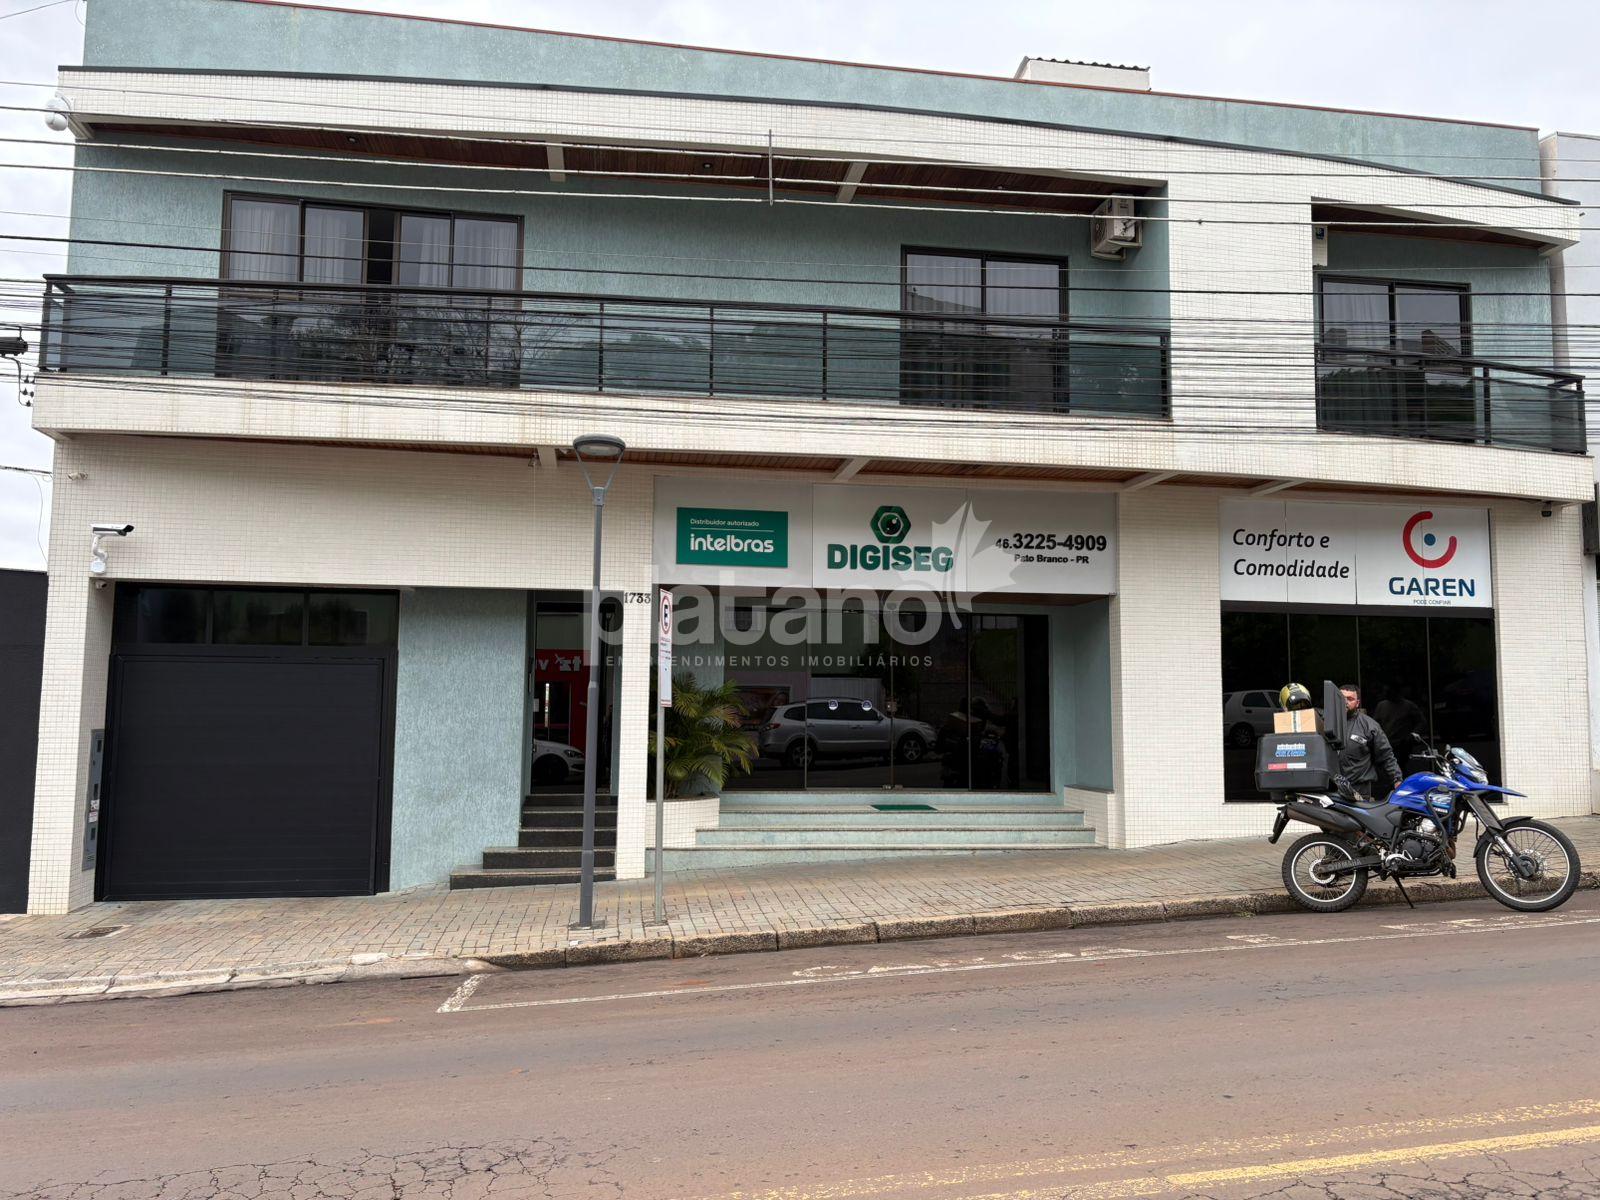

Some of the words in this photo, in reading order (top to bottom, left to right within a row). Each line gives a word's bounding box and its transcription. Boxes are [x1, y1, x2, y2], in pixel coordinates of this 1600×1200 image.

[690, 518, 726, 526] Distribuidor
[727, 519, 760, 527] autorizado
[690, 533, 775, 553] intelbras
[995, 533, 1107, 551] 46.3225-4909
[1232, 528, 1315, 552] Conforto
[1319, 535, 1330, 549] e
[827, 543, 954, 572] DIGISEG
[1014, 554, 1035, 562] Pato
[1036, 555, 1069, 563] Branco
[1076, 555, 1089, 564] PR
[1233, 558, 1350, 579] Comodidade
[1388, 577, 1476, 597] GAREN
